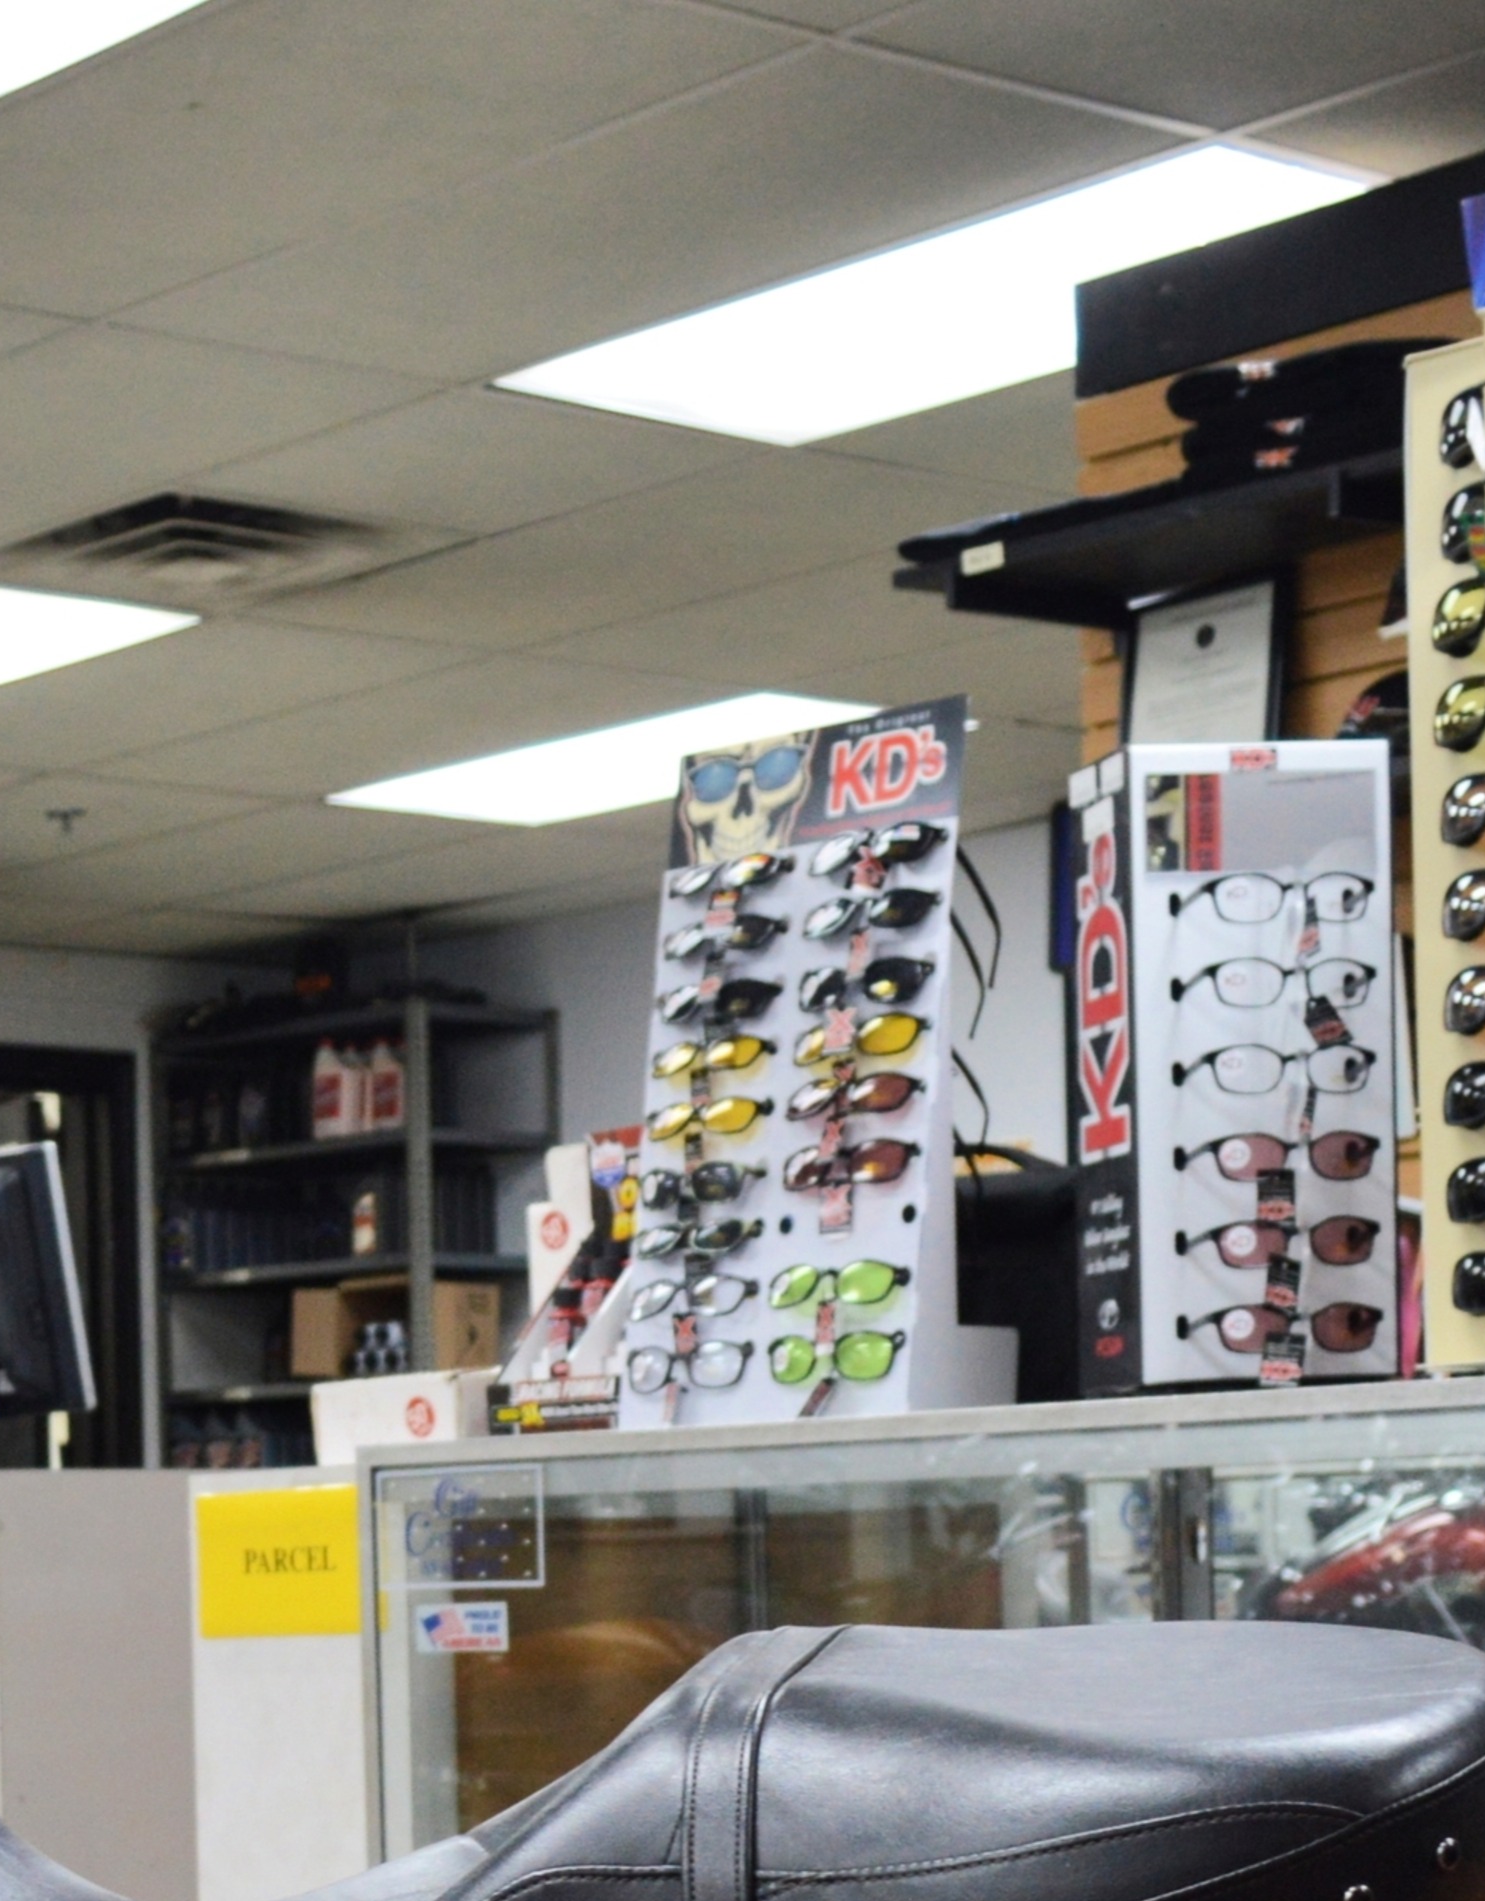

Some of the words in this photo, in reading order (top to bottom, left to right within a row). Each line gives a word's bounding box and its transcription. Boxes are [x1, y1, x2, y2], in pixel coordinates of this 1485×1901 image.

[825, 726, 948, 819] KD's
[1076, 832, 1131, 1165] KD's
[243, 1546, 337, 1575] PARCEL
